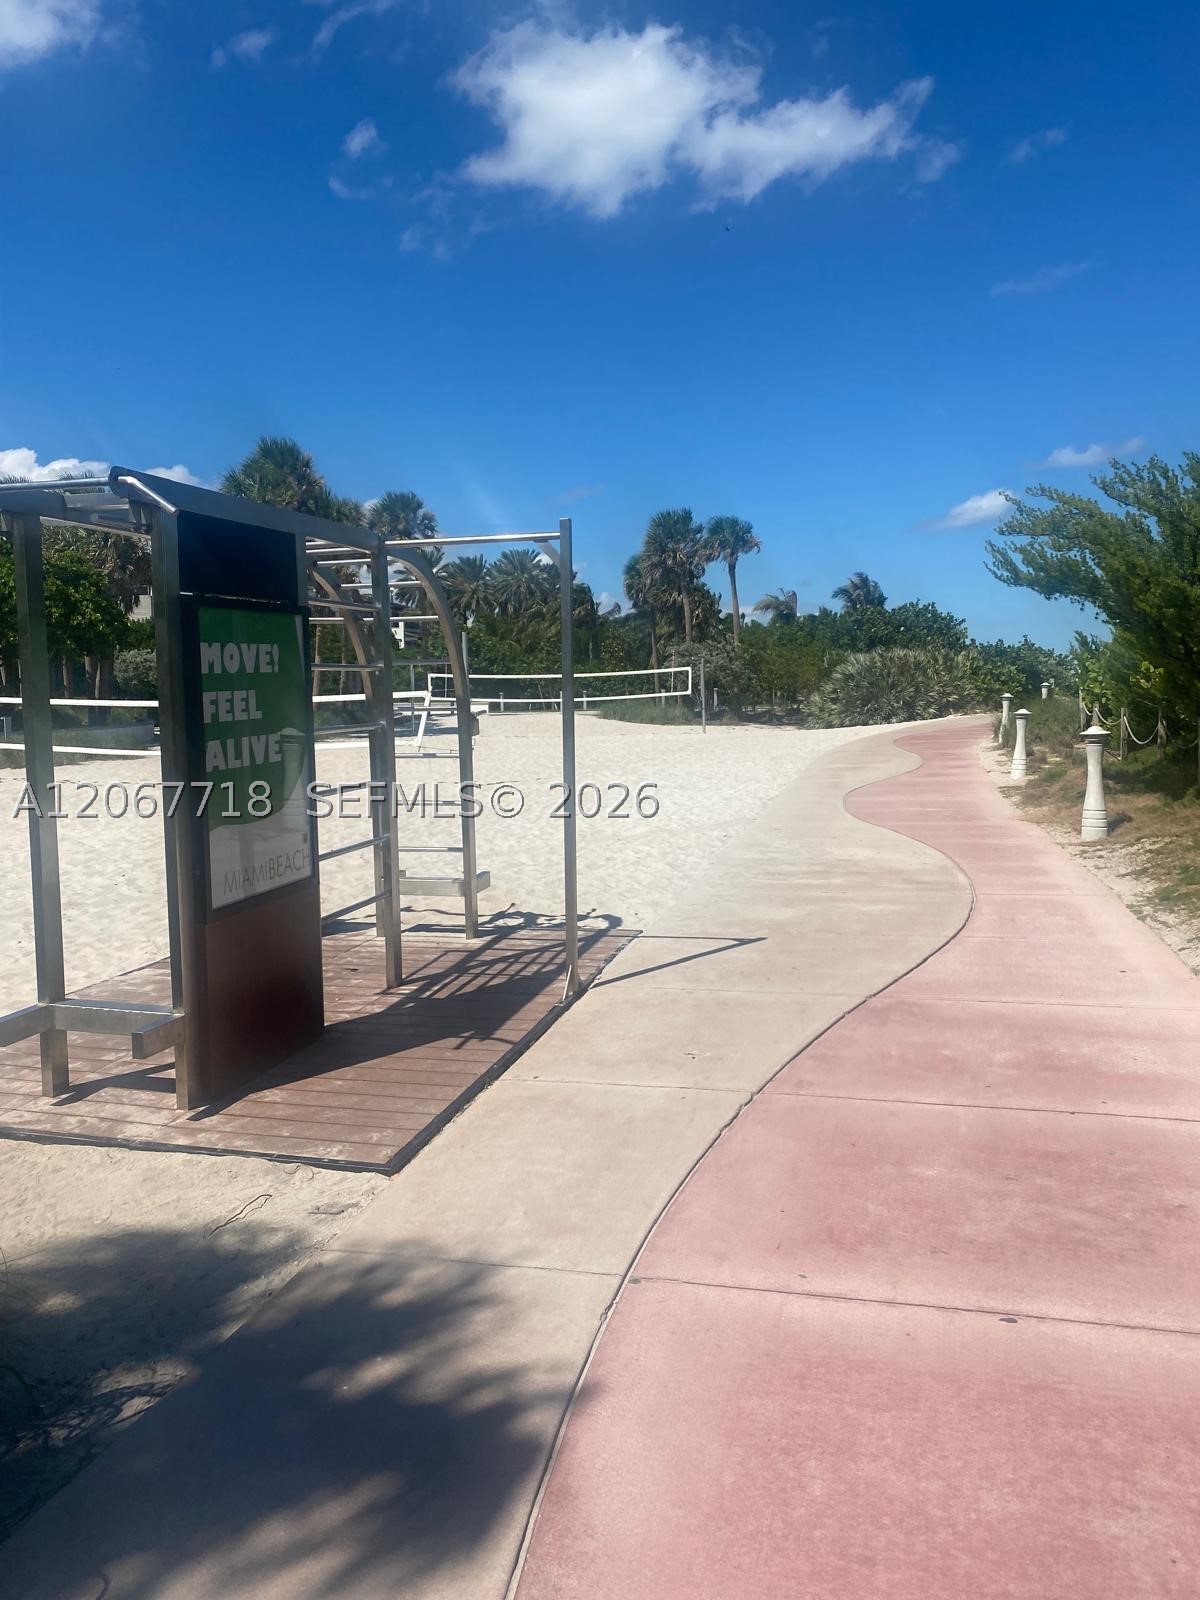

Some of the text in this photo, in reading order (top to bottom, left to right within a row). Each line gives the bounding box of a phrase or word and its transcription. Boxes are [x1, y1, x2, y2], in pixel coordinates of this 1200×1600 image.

[201, 642, 280, 674] MOVE!
[203, 690, 262, 723] FEEL
[206, 735, 282, 772] ALIVE
